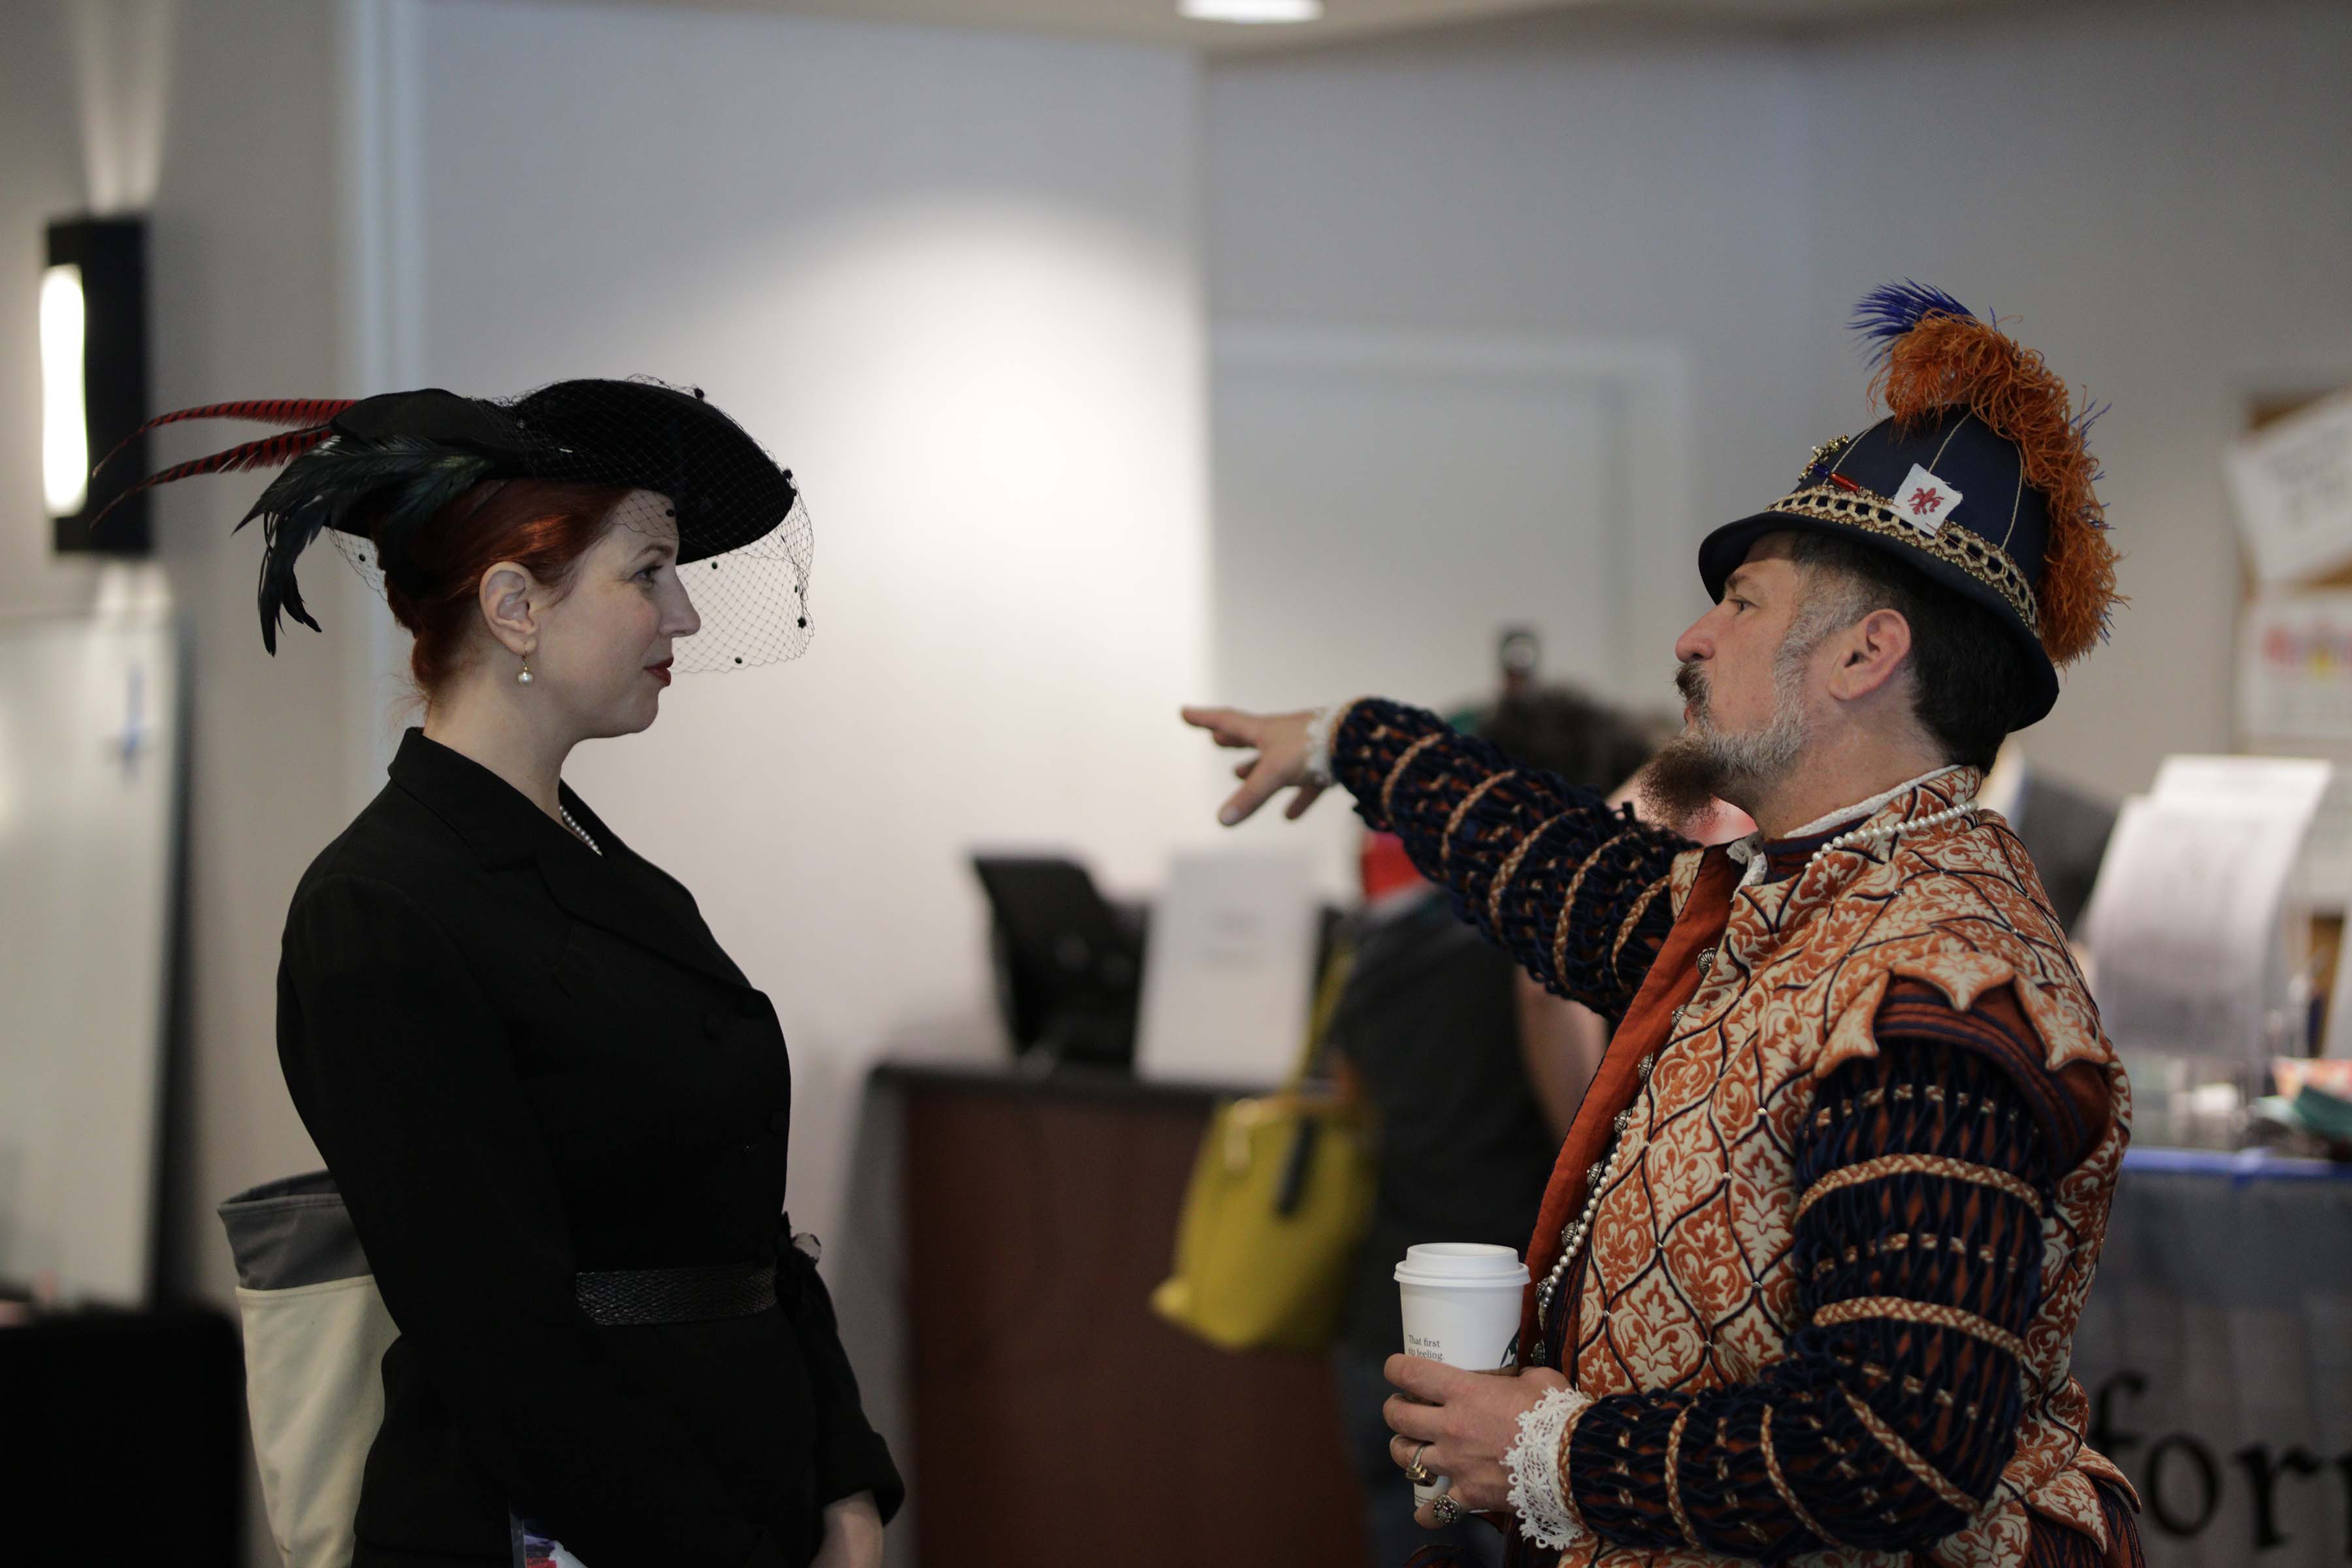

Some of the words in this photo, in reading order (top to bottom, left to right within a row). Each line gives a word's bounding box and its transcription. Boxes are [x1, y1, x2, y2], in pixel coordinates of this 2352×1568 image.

[1409, 1334, 1422, 1346] That
[1424, 1337, 1440, 1348] first
[1416, 1348, 1445, 1362] feeling.
[2089, 1371, 2352, 1558] for
